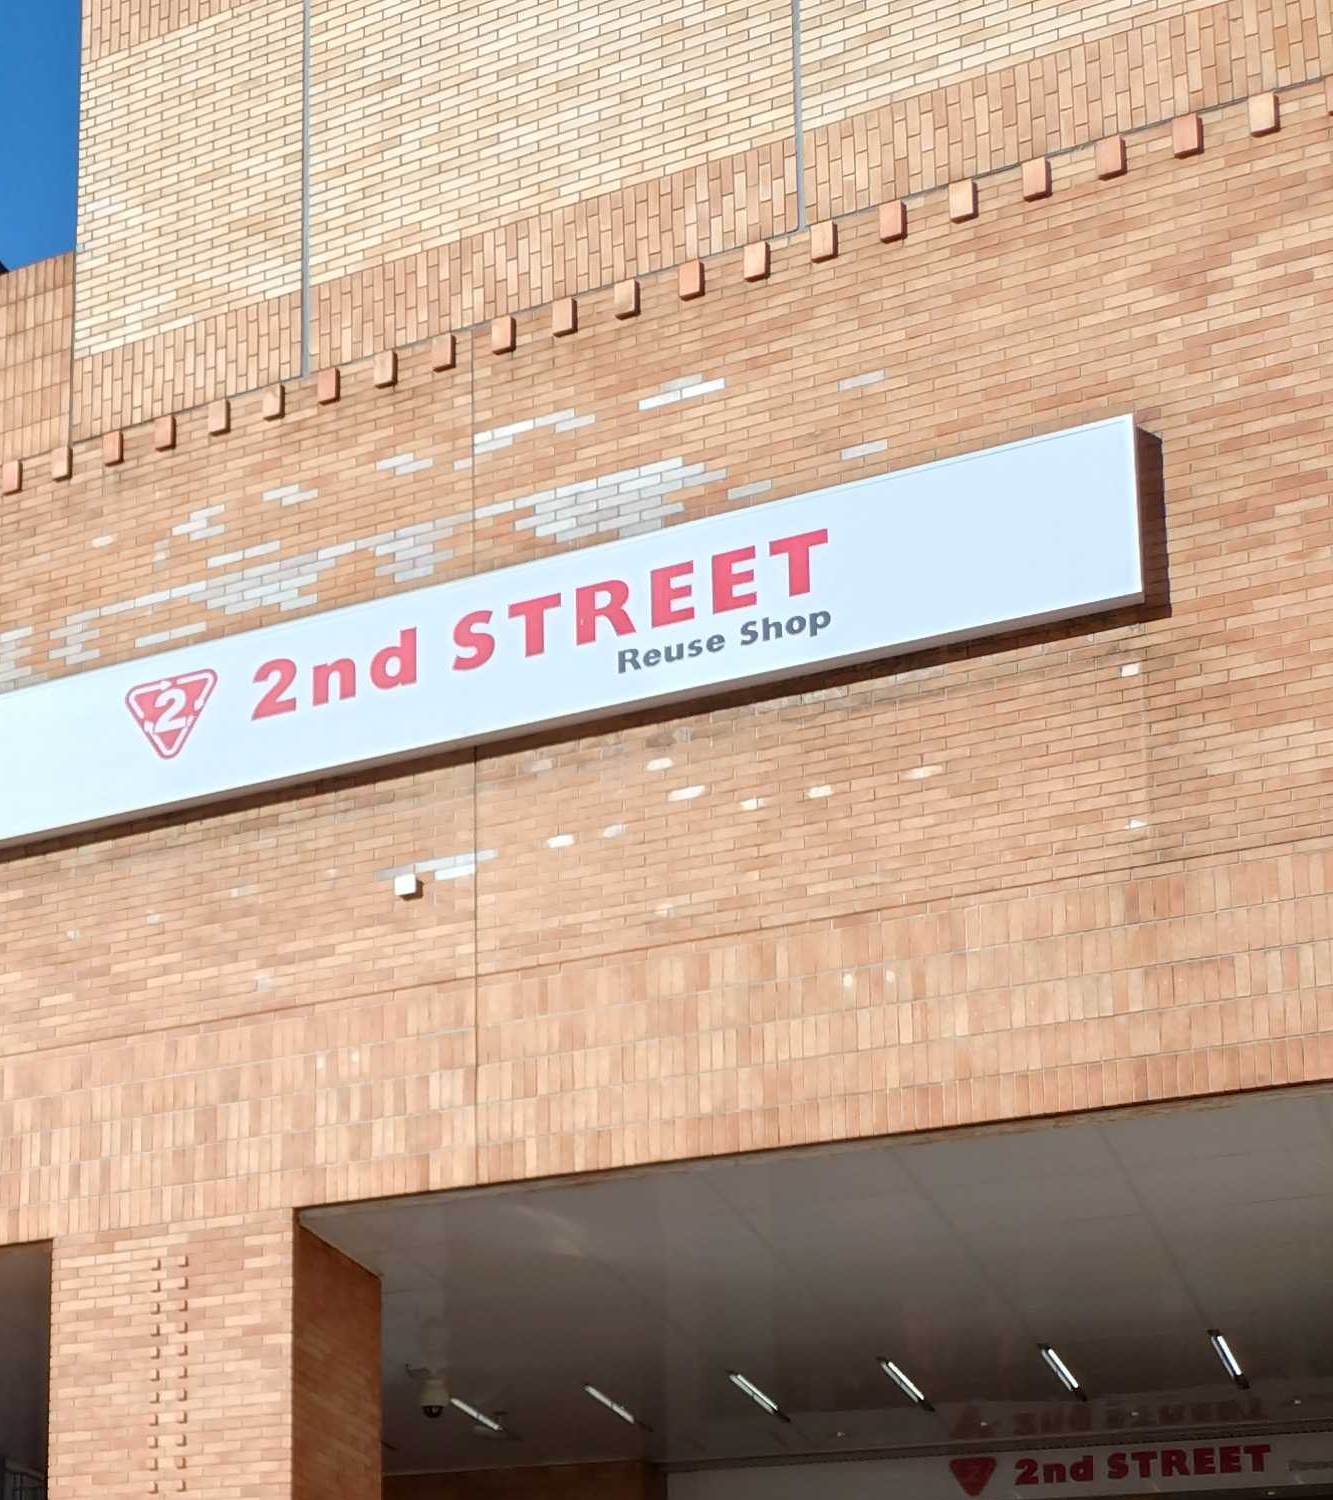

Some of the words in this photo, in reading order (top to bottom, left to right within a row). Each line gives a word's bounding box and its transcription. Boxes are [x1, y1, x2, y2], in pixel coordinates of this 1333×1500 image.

[250, 626, 418, 722] 2nd
[449, 528, 831, 672] STREET
[617, 630, 727, 675] Reuse
[739, 607, 833, 647] Shop
[1014, 1455, 1094, 1486] 2nd
[1106, 1444, 1273, 1480] STREET
